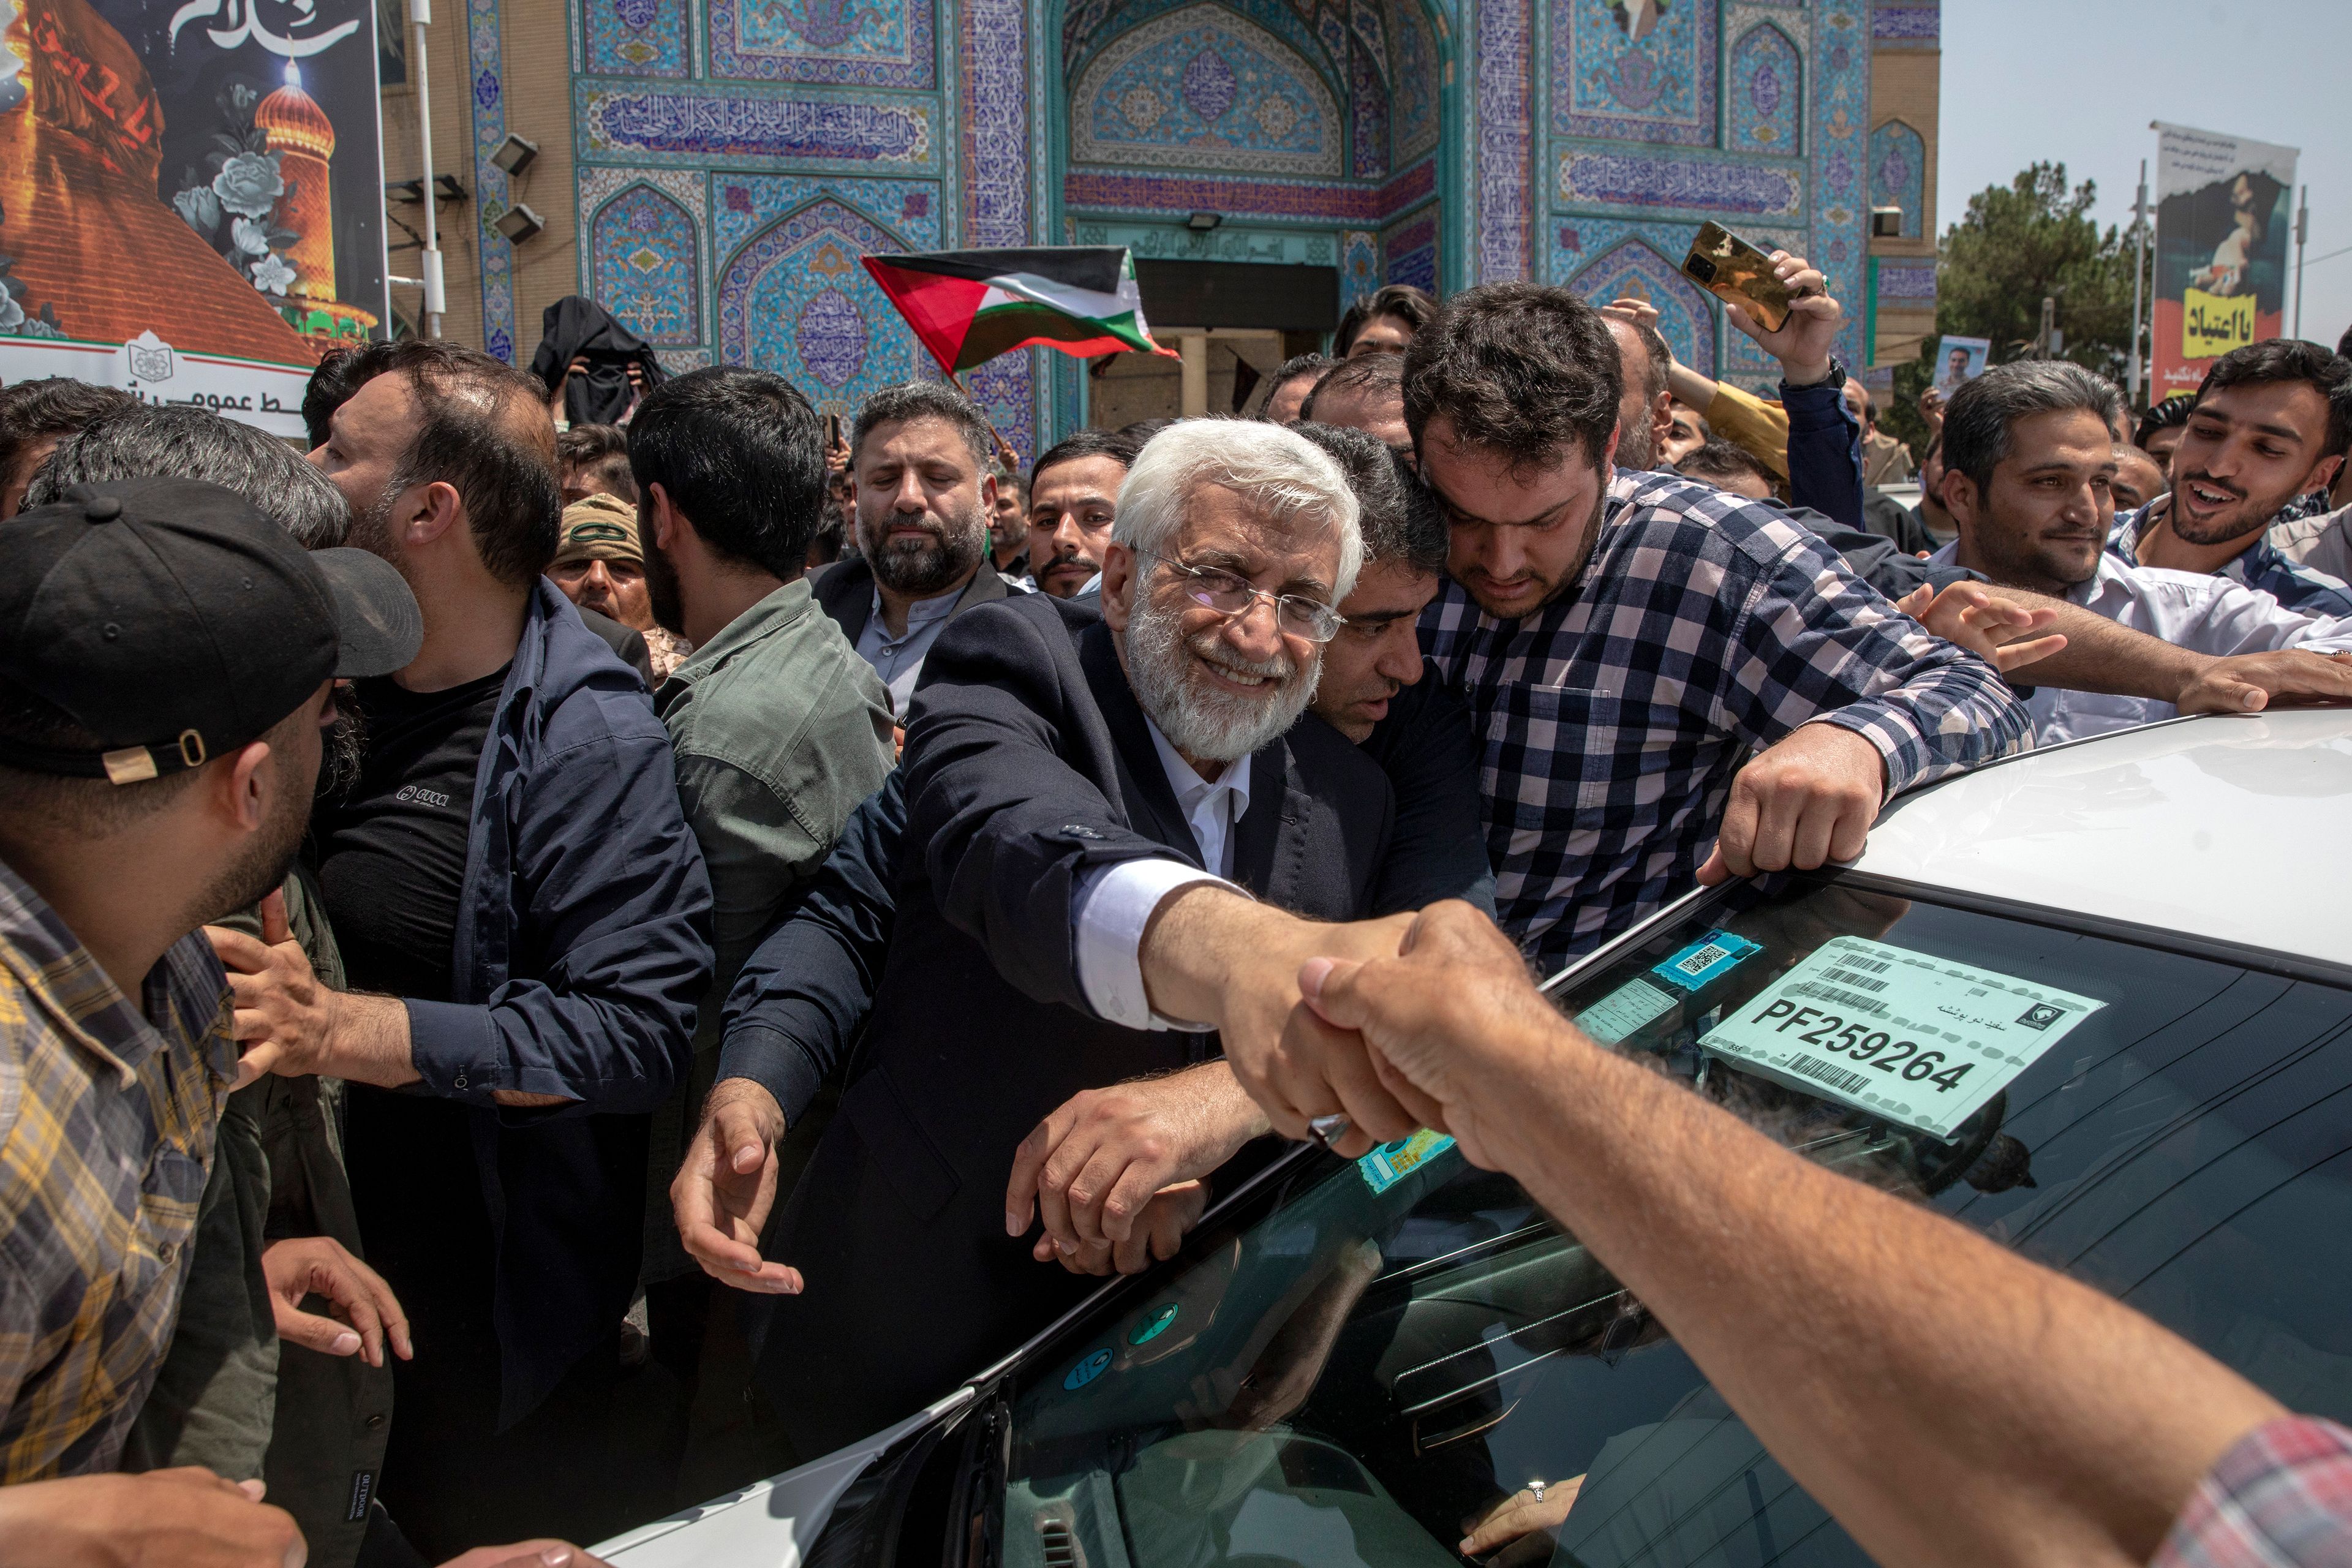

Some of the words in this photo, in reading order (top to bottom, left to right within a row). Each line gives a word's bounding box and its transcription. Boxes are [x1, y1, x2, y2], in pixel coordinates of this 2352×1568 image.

[417, 789, 450, 807] GUCCI
[1728, 1044, 1744, 1052] 555
[1751, 998, 1975, 1093] PF259264
[355, 1474, 371, 1518] OUTDOOR
